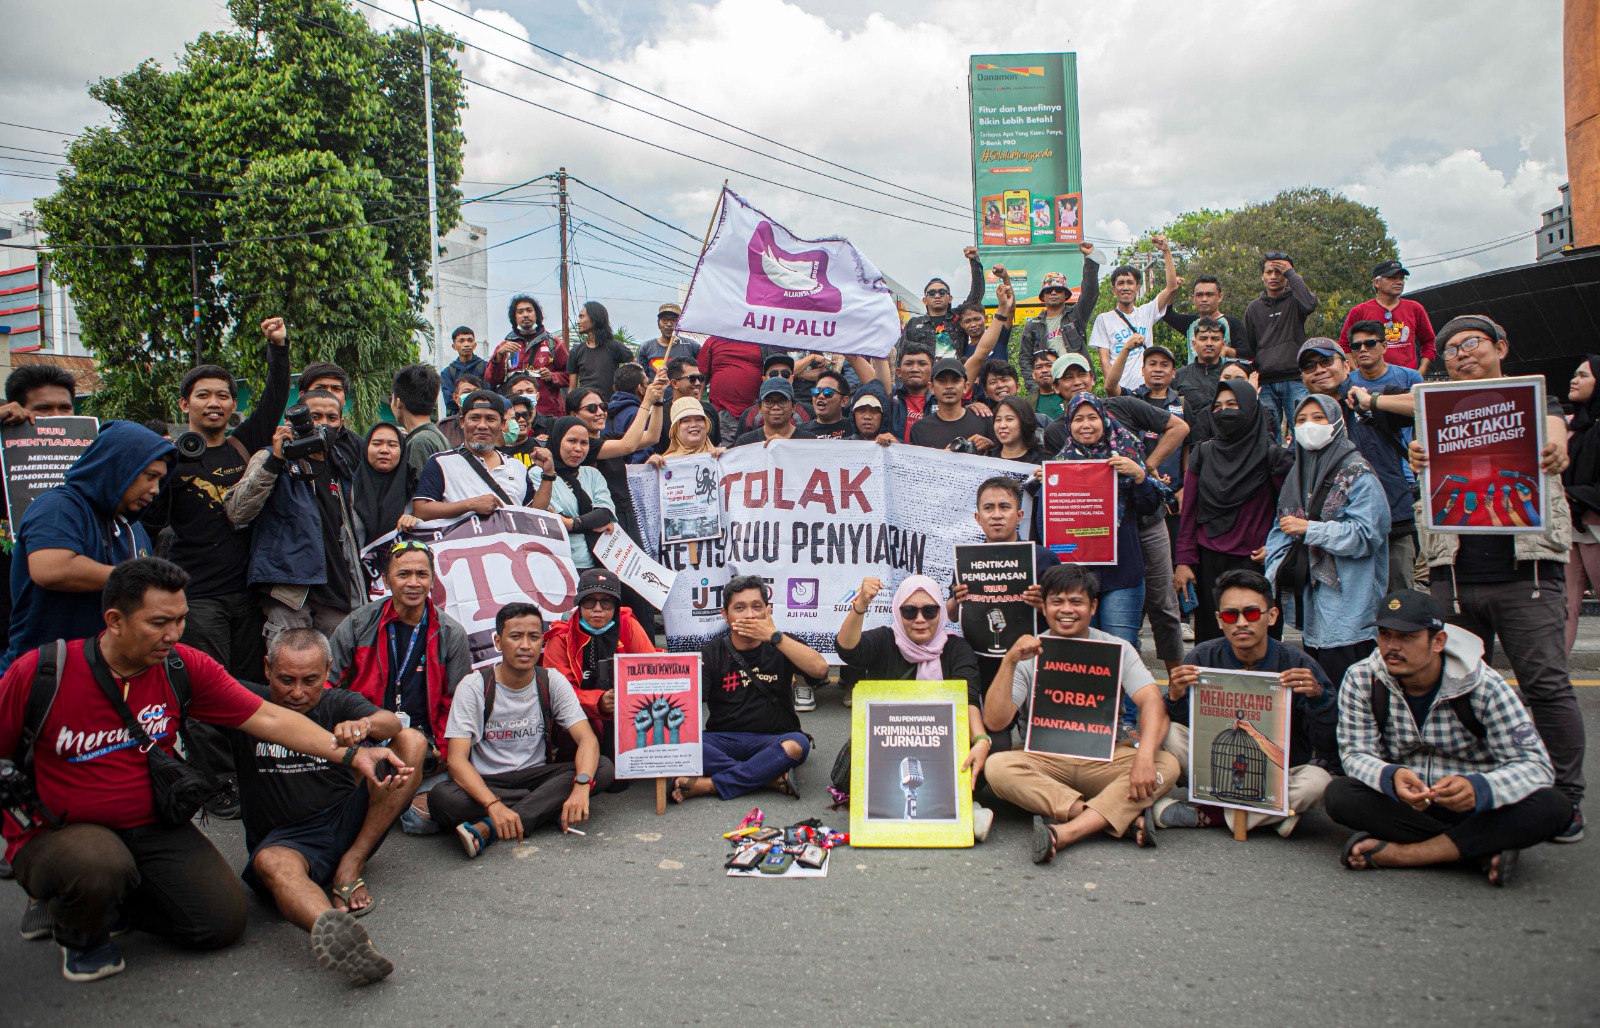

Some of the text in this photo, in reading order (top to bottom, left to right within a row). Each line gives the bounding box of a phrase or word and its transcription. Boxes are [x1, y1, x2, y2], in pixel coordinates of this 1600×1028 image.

[977, 73, 1018, 82] Danamon
[979, 103, 1062, 114] Fitur dan Benefitnya
[1002, 117, 1024, 125] Lebih
[1026, 115, 1053, 124] Betah!
[743, 312, 837, 337] AJI PALU
[1445, 401, 1516, 425] PEMERINTAH
[37, 427, 66, 435] RUU
[1438, 411, 1525, 443] KOK TAKUT
[5, 438, 93, 448] PENYIARAN
[1438, 427, 1526, 454] DIINVESTIGASI?
[11, 473, 65, 481] DEMOKRASI,
[720, 465, 873, 514] TOLAK
[728, 521, 780, 563] RUU
[792, 521, 926, 575] PENYIARAN
[970, 560, 1018, 569] HENTIKAN
[962, 572, 1027, 581] PEMBAHASAN
[627, 664, 645, 676] TOLAK
[659, 663, 690, 676] PENYIARAN
[1043, 661, 1111, 677] JANGAN ADA
[1200, 690, 1273, 712] MENGEKANG
[509, 718, 528, 729] GOD
[1033, 717, 1112, 735] DIANTARA KITA
[873, 726, 948, 735] KRIMINALISASI
[881, 736, 940, 747] JURNALIS
